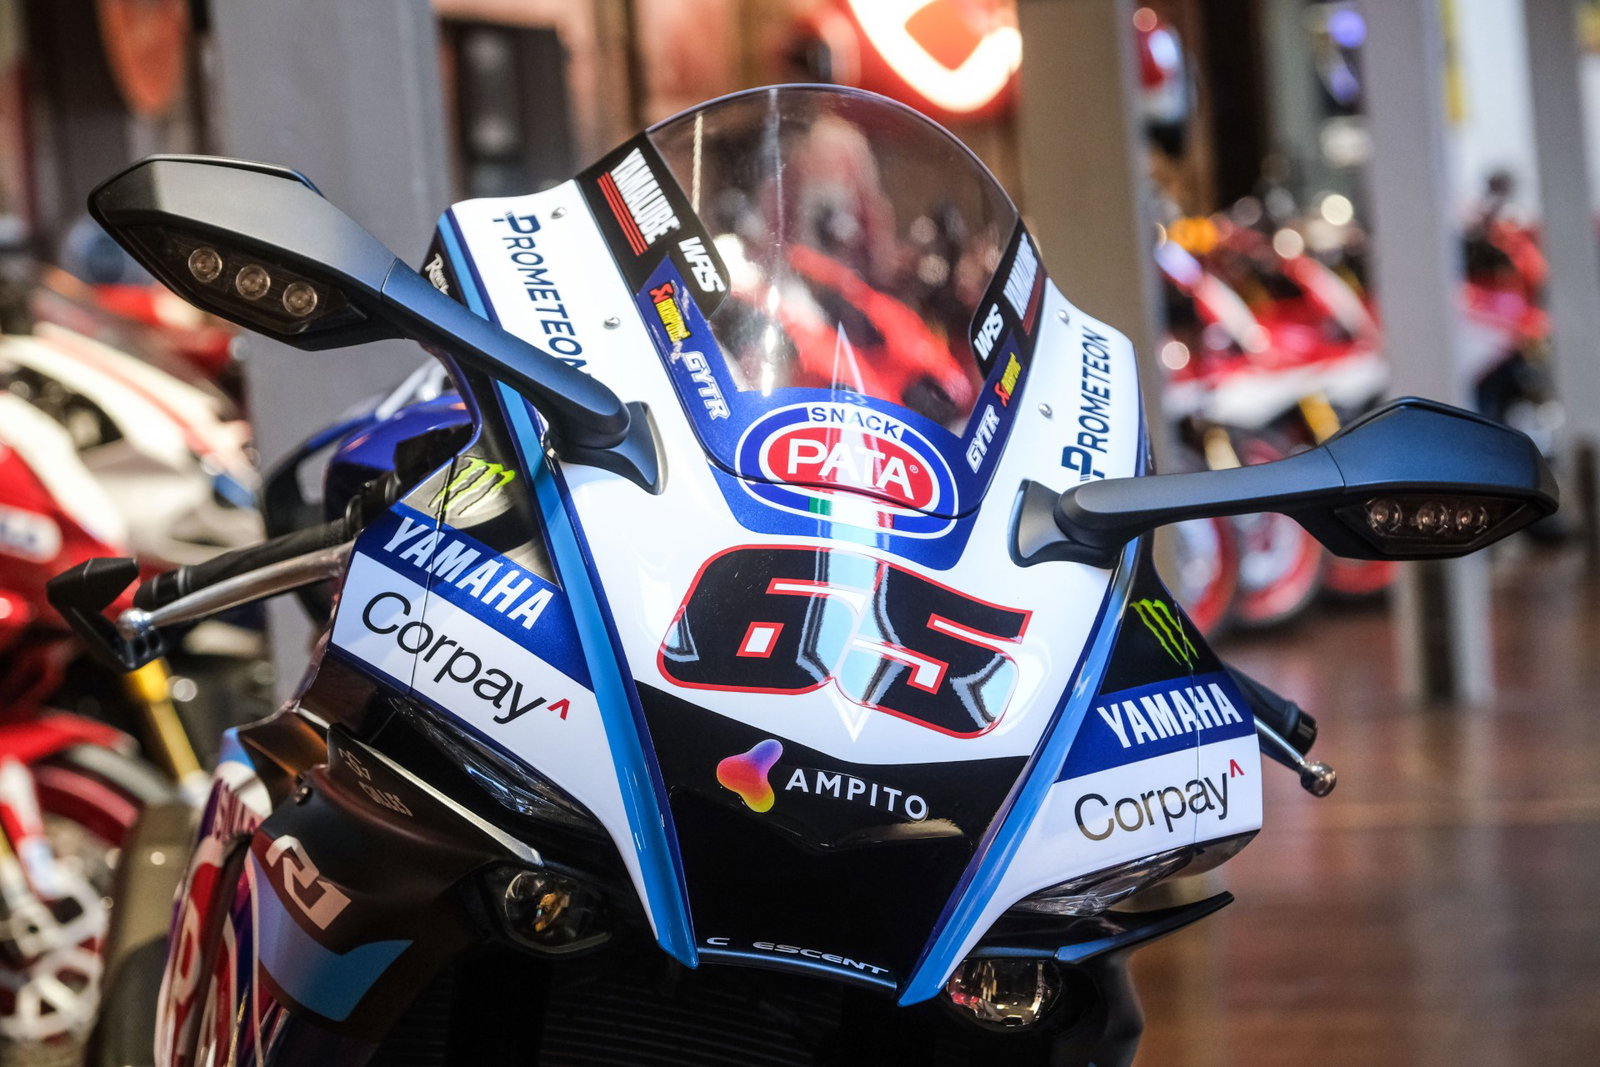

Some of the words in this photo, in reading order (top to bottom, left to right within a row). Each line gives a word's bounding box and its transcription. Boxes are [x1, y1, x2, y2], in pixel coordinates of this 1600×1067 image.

[610, 147, 681, 245] YAMALUBE
[678, 236, 726, 292] WRS
[973, 303, 1004, 361] WRS
[681, 350, 731, 421] GYTR
[1061, 326, 1111, 482] PROMETEON
[811, 407, 899, 439] SNACK
[966, 404, 1000, 475] GYTR
[383, 516, 554, 630] YAMAHA
[362, 591, 547, 725] Corpay
[656, 543, 1033, 739] 65
[1097, 683, 1243, 749] YAMAHA
[785, 768, 927, 820] AMPITO
[1074, 772, 1228, 841] Corpay
